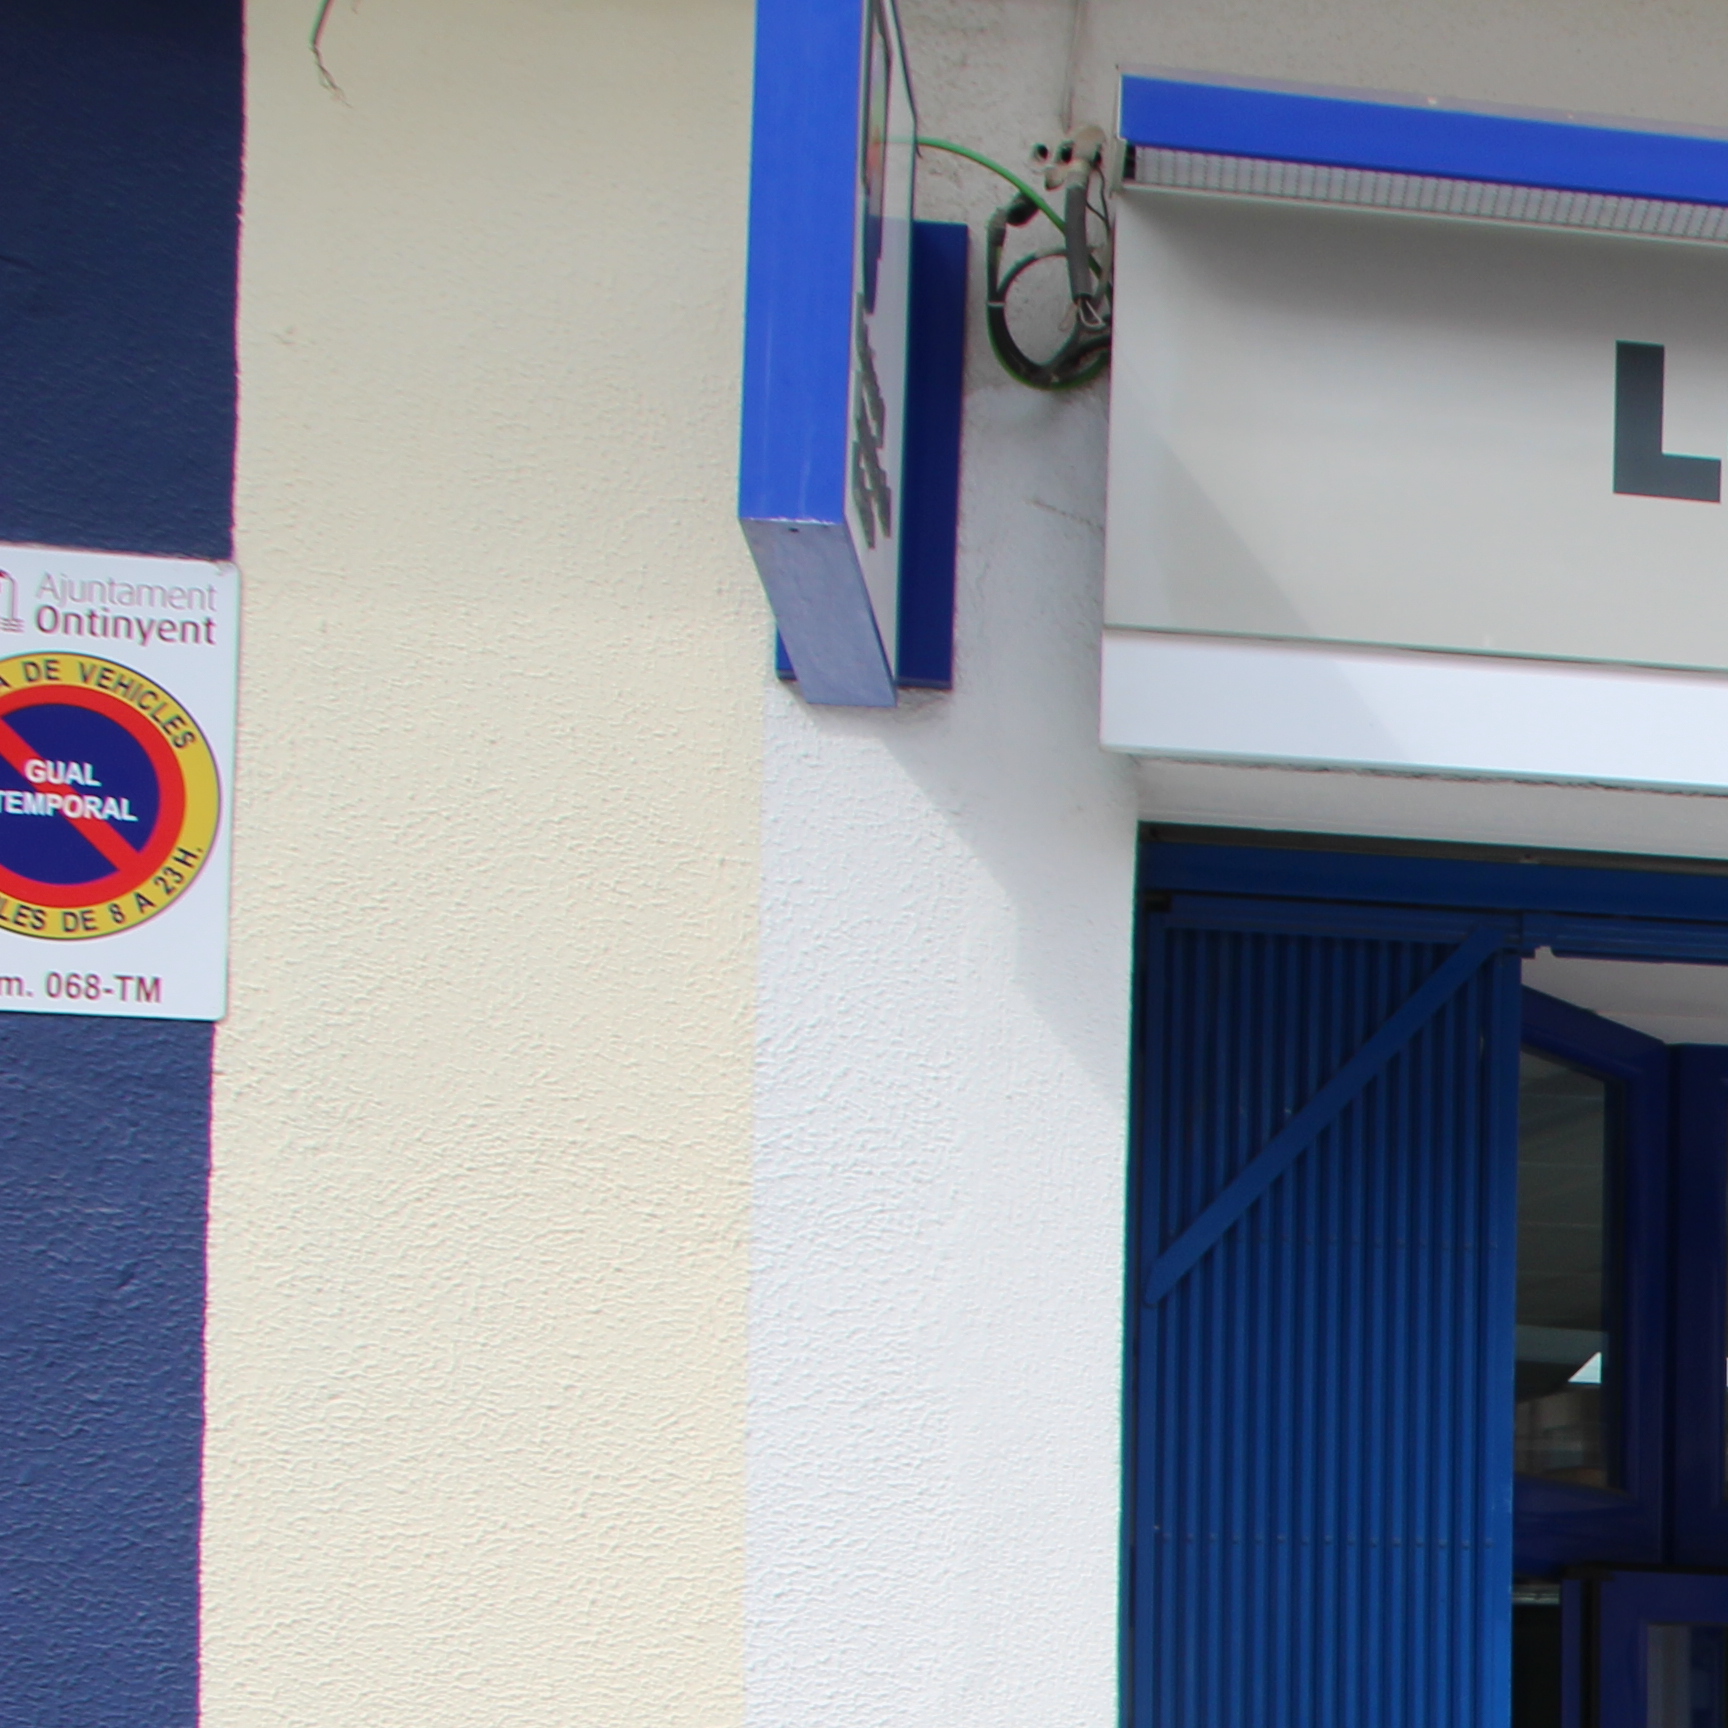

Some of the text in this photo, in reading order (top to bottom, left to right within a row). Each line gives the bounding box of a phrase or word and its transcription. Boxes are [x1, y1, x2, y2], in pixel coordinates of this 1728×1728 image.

[35, 571, 217, 613] Ajuntament
[35, 604, 217, 647] Ontinyent
[22, 659, 197, 750] DE VEHICLES
[25, 758, 102, 787] GUAL
[62, 909, 98, 933] DE
[110, 902, 127, 926] 8
[135, 890, 157, 914] A
[45, 970, 163, 1004] 068-TM
